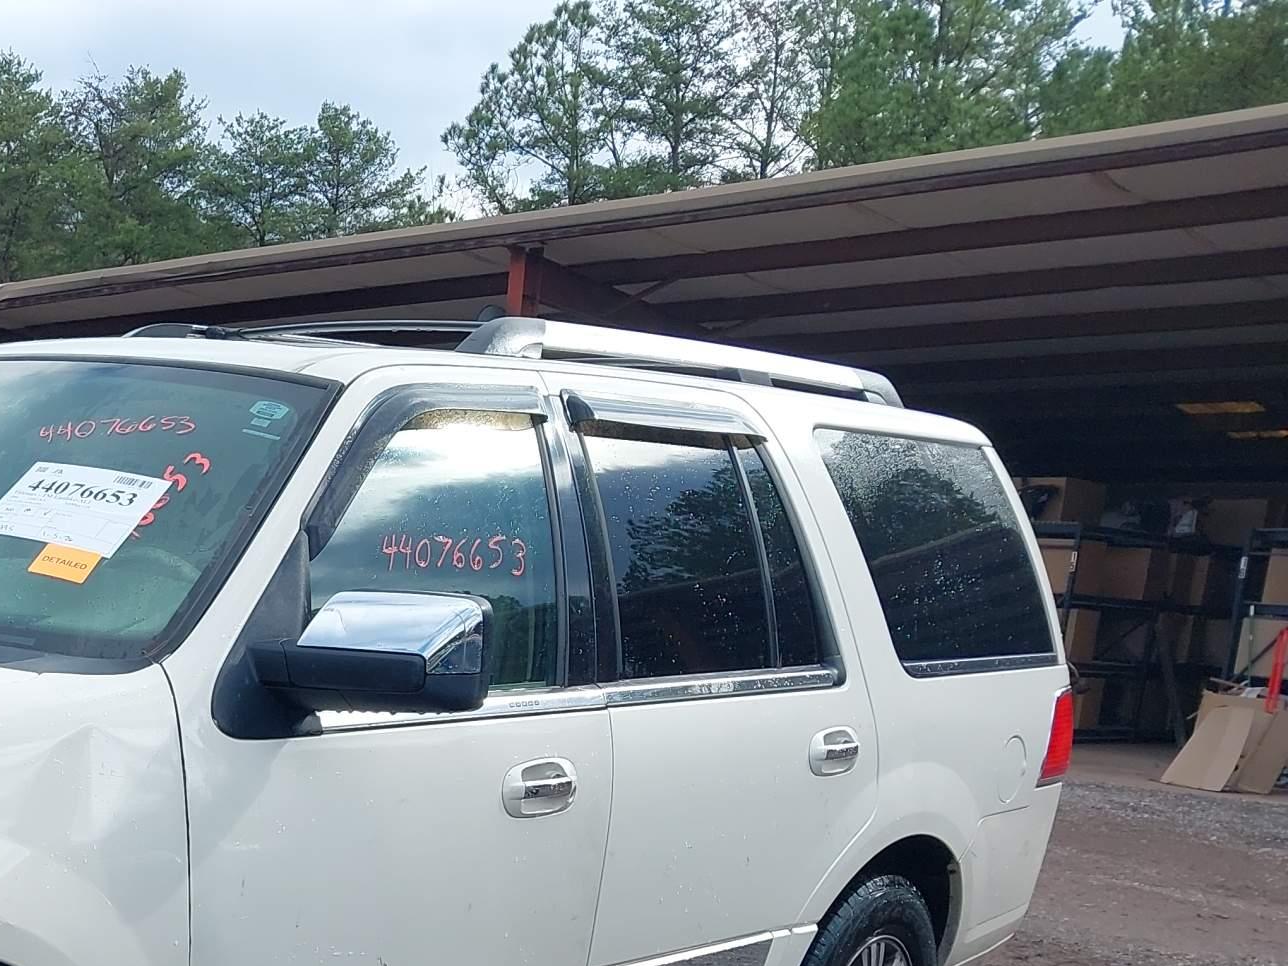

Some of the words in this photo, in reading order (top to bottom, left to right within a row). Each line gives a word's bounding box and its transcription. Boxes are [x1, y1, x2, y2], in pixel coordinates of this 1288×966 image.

[39, 415, 196, 443] 44076653
[27, 478, 139, 508] 44076653
[42, 555, 88, 571] DETAILED
[382, 533, 527, 577] 44076653
